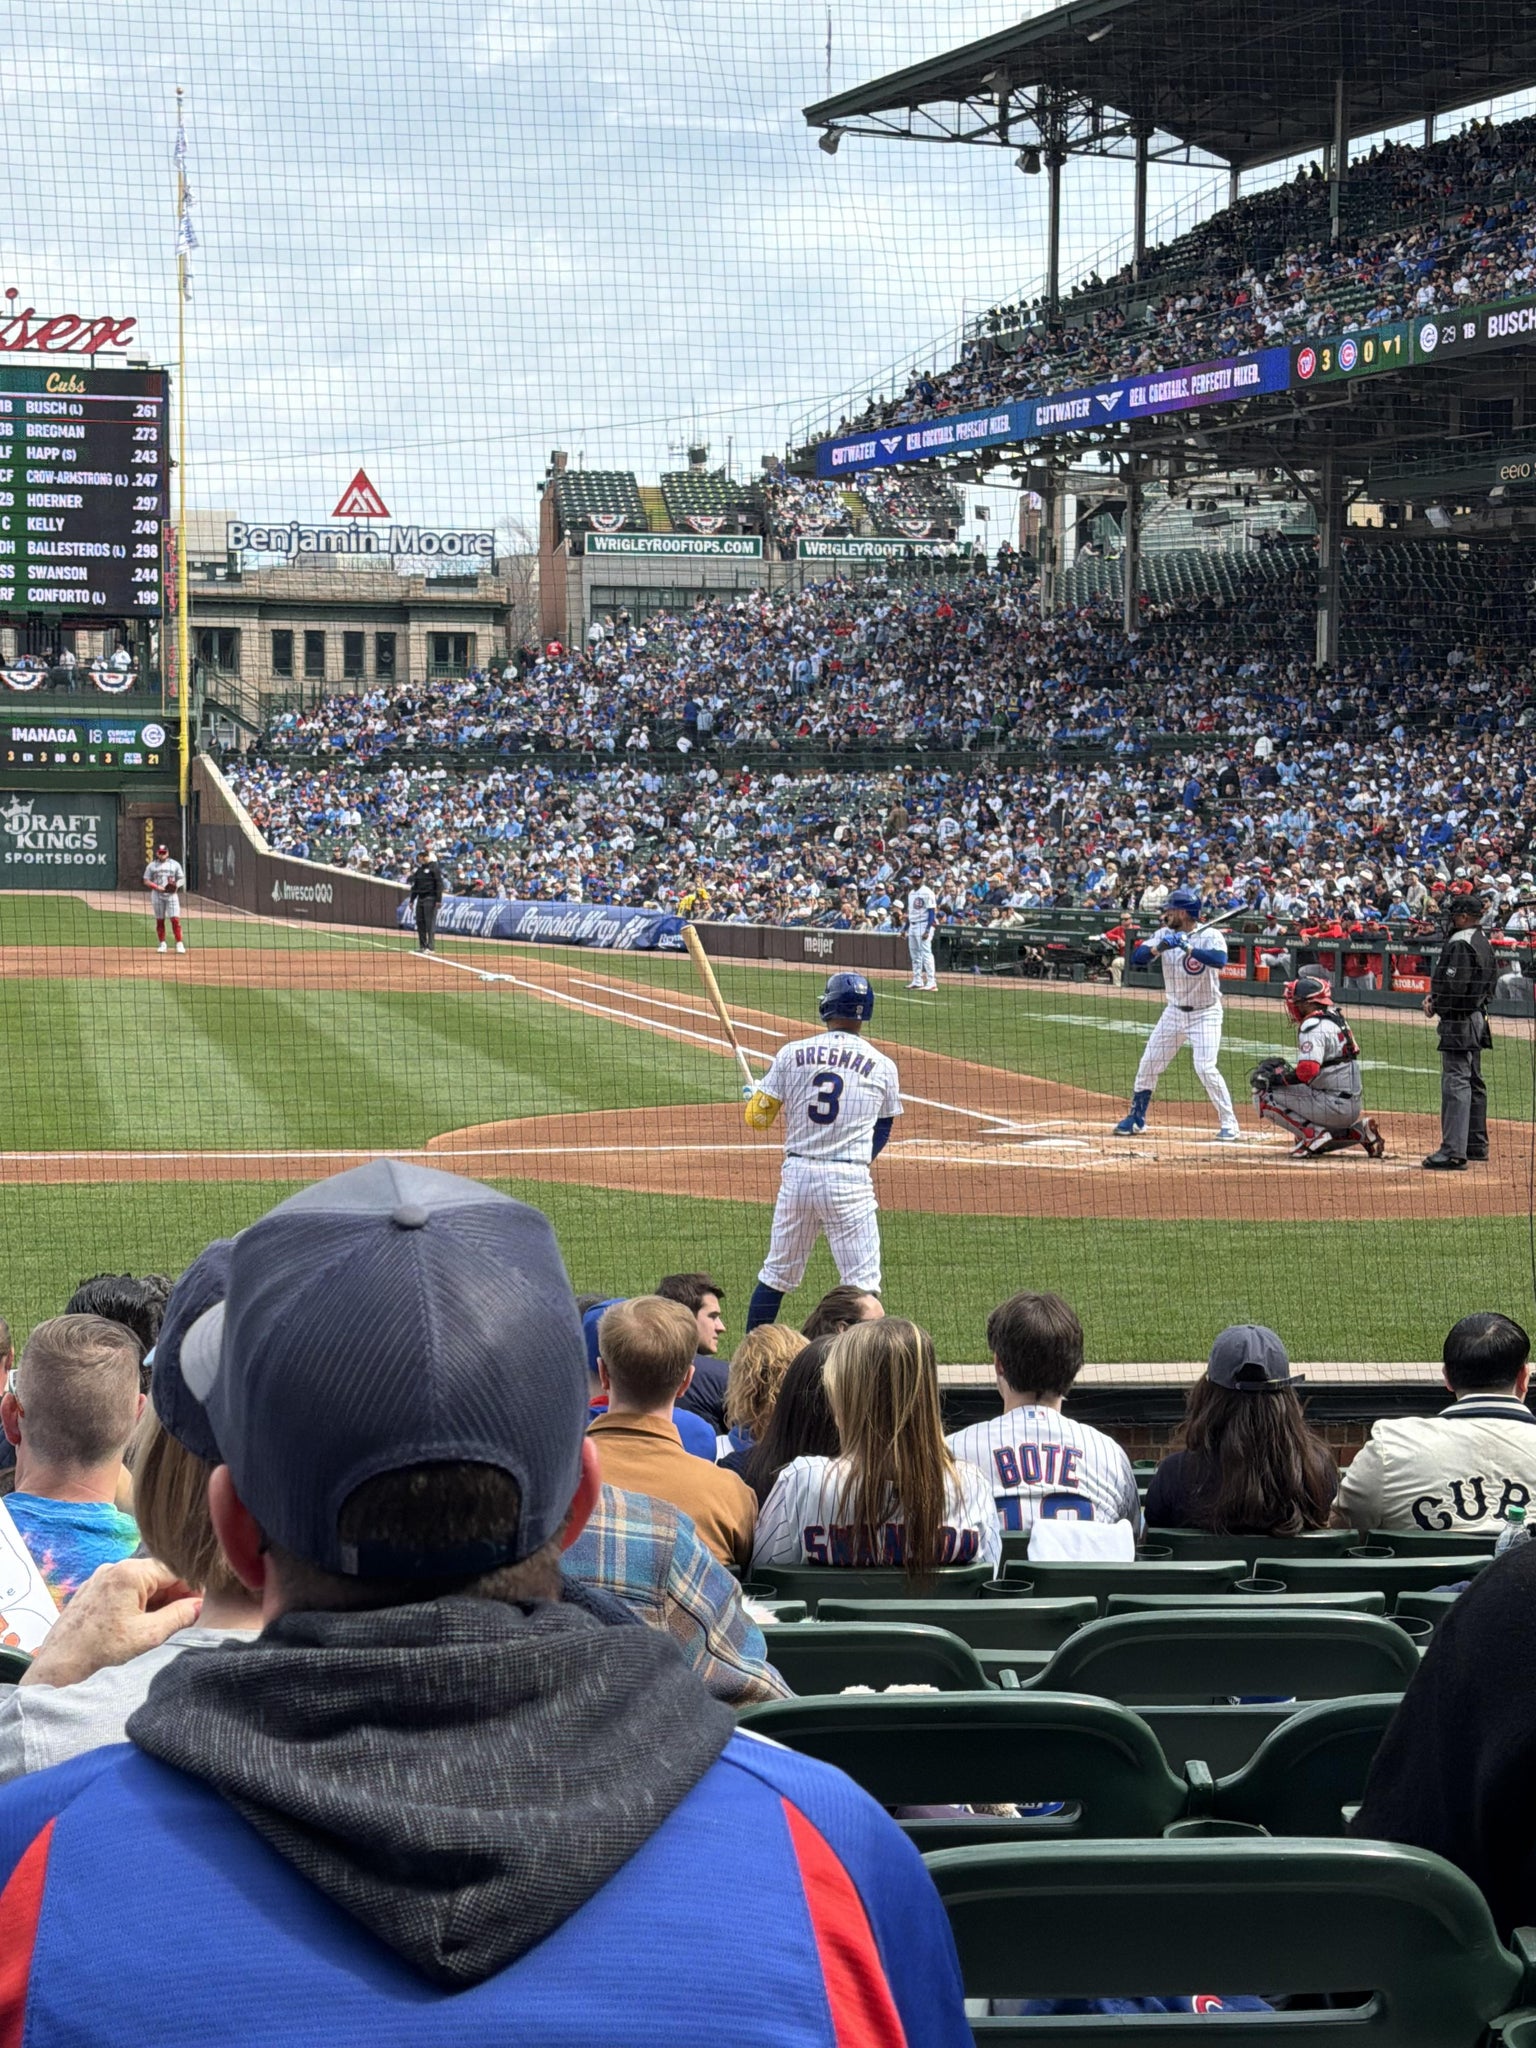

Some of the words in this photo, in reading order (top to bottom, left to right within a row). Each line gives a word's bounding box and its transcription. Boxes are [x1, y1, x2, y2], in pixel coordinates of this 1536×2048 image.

[1441, 325, 1456, 345] 29
[1463, 323, 1475, 339] 1B
[1488, 309, 1536, 339] BUSCH
[1363, 340, 1374, 363] 0
[1395, 334, 1401, 354] 1
[1321, 349, 1331, 371] 3
[46, 372, 86, 393] Cubs
[1036, 398, 1092, 426] CUTWATER
[1129, 387, 1148, 407] REAL
[1149, 378, 1190, 403] COCKTAILS.
[1191, 368, 1231, 396] PERFECTLY
[1233, 363, 1261, 387] MIXED.
[26, 401, 67, 415] BUSCH
[69, 404, 83, 416] (L)
[132, 404, 157, 418] .261
[26, 424, 86, 438] BREGMAN
[132, 427, 158, 441] .273
[0, 446, 13, 460] LF
[26, 446, 60, 460] HAPP
[62, 449, 77, 462] (S)
[131, 450, 158, 464] .243
[832, 441, 877, 466] CUTWATER
[0, 469, 14, 482] CF
[26, 470, 113, 486] CROW-ARMSTRONG
[115, 474, 129, 487] (L)
[131, 474, 158, 487] .247
[0, 493, 14, 506] 2B
[27, 493, 83, 508] HOERNER
[132, 497, 158, 511] .297
[2, 516, 11, 530] C
[27, 517, 65, 531] KELLY
[131, 520, 158, 534] .249
[0, 540, 15, 554] DH
[27, 541, 110, 557] BALLESTEROS
[112, 545, 126, 558] (L)
[132, 544, 158, 558] .298
[226, 520, 381, 559] Benjamin
[389, 524, 496, 556] Moore
[594, 536, 754, 554] WRIGLEYROOFTOPS.COM
[0, 565, 15, 579] SS
[28, 565, 88, 580] SWANSON
[131, 568, 158, 582] .244
[0, 588, 15, 601] RF
[28, 588, 90, 602] CONFORTO
[92, 592, 106, 605] (L)
[133, 591, 159, 605] .199
[12, 727, 77, 743] IMANAGA
[89, 729, 102, 744] 18
[8, 751, 15, 762] 3
[40, 751, 48, 762] 3
[72, 752, 80, 763] 0
[104, 753, 112, 764] 3
[148, 754, 159, 764] 21
[4, 814, 101, 835] DRAFT
[16, 830, 98, 850] KINGS
[4, 852, 107, 865] SPORTSBOOK
[283, 880, 315, 902] Invesco
[450, 902, 485, 935] Wrap
[515, 906, 581, 942] Reynolds
[576, 910, 621, 948] Wrap
[803, 932, 834, 958] meijer
[795, 1045, 876, 1079] BREGMAN
[808, 1072, 844, 1125] 3
[993, 1442, 1084, 1489] BOTE
